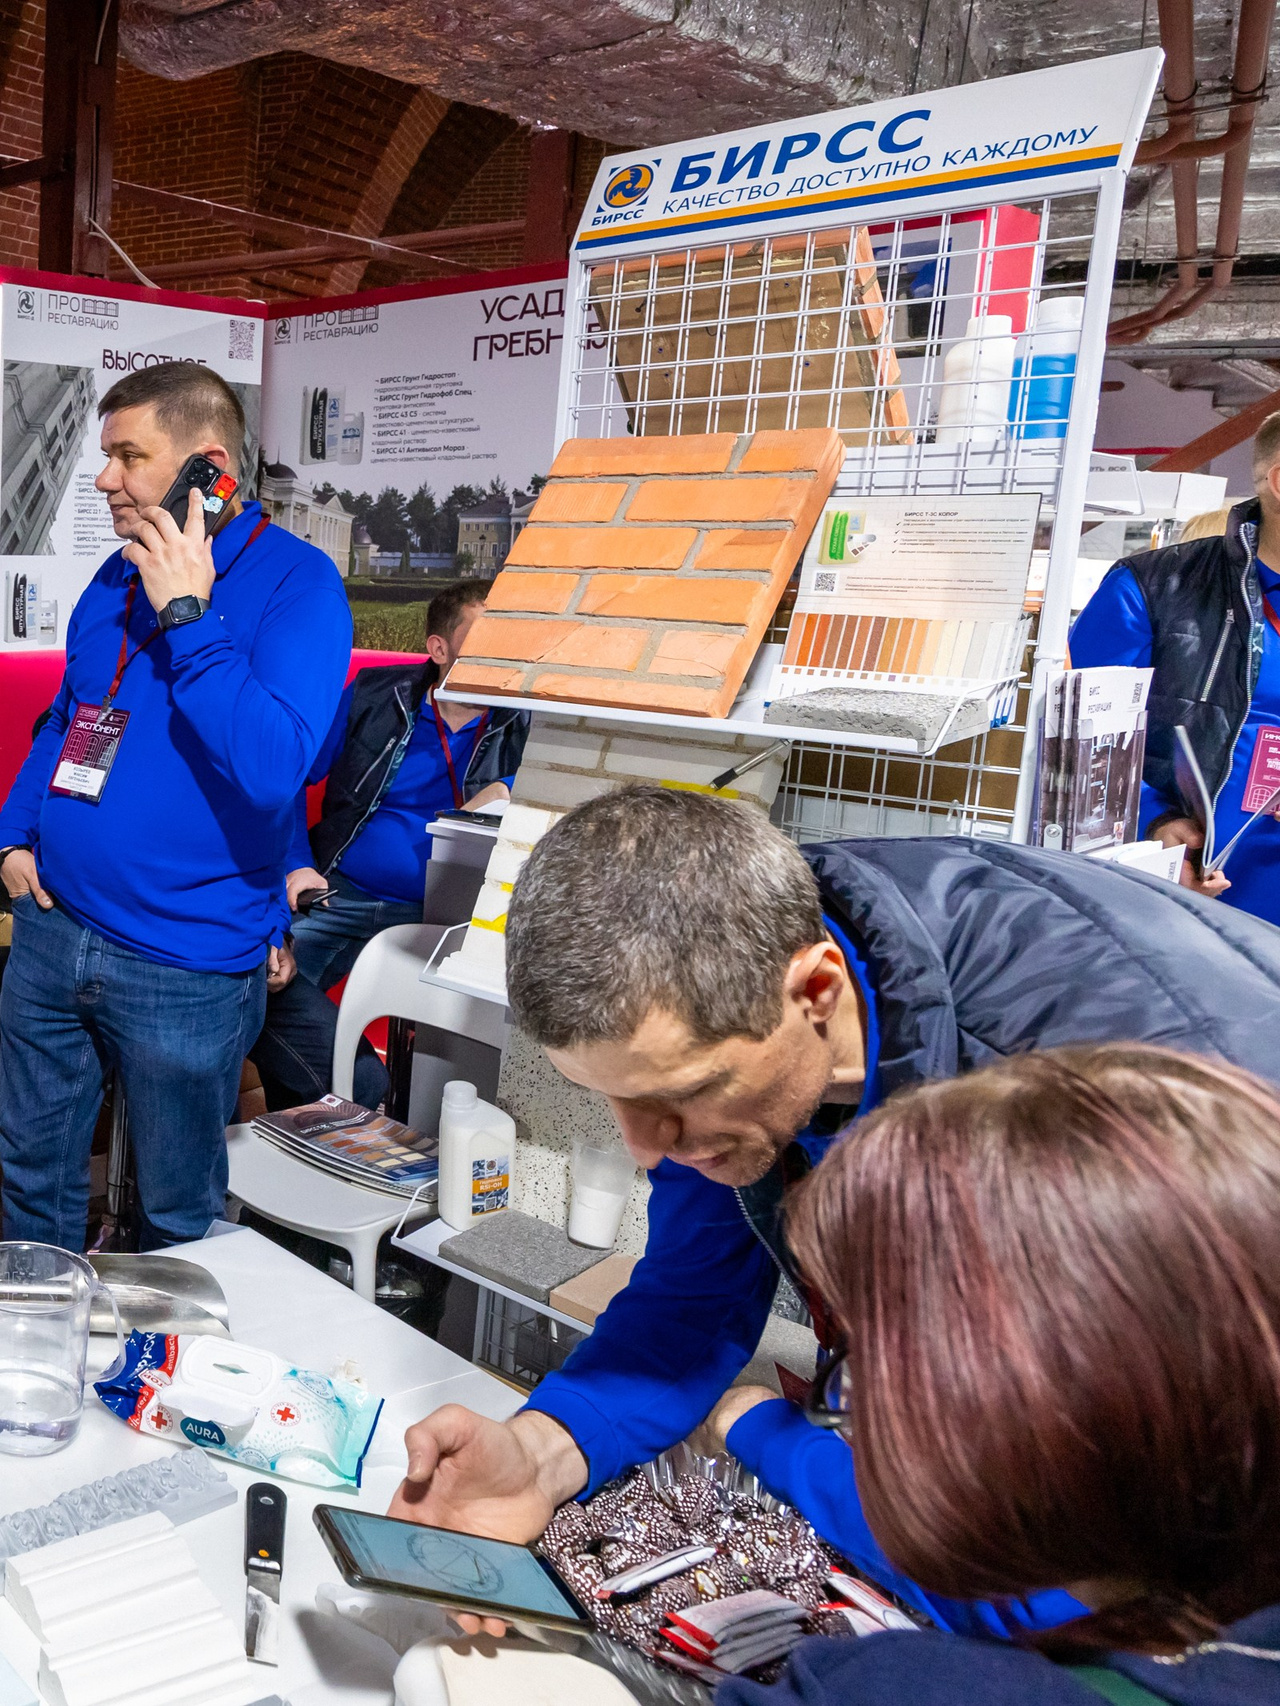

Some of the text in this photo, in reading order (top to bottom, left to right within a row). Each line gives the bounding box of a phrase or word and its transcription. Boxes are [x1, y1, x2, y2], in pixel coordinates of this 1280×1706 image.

[670, 108, 932, 194] БИРСС
[662, 125, 1099, 215] КАЧЕСТВО ДОСТУПНО КАЖДОМУ
[591, 208, 644, 227] БИРСС
[48, 293, 81, 313] ПРО
[480, 288, 565, 324] УСАД
[48, 312, 119, 331] РЕСТАВРАЦИЮ
[304, 311, 337, 329] ПРО
[303, 322, 379, 342] РЕСТАВРАЦИЮ
[380, 372, 456, 384] БИРСС Грунт Гидростоп
[379, 393, 400, 402] БИРСС
[401, 393, 419, 402] Грунт
[378, 411, 399, 420] БИРСС
[76, 720, 120, 736] ЭКСПОНЕНТ
[185, 1422, 220, 1443] AURA
